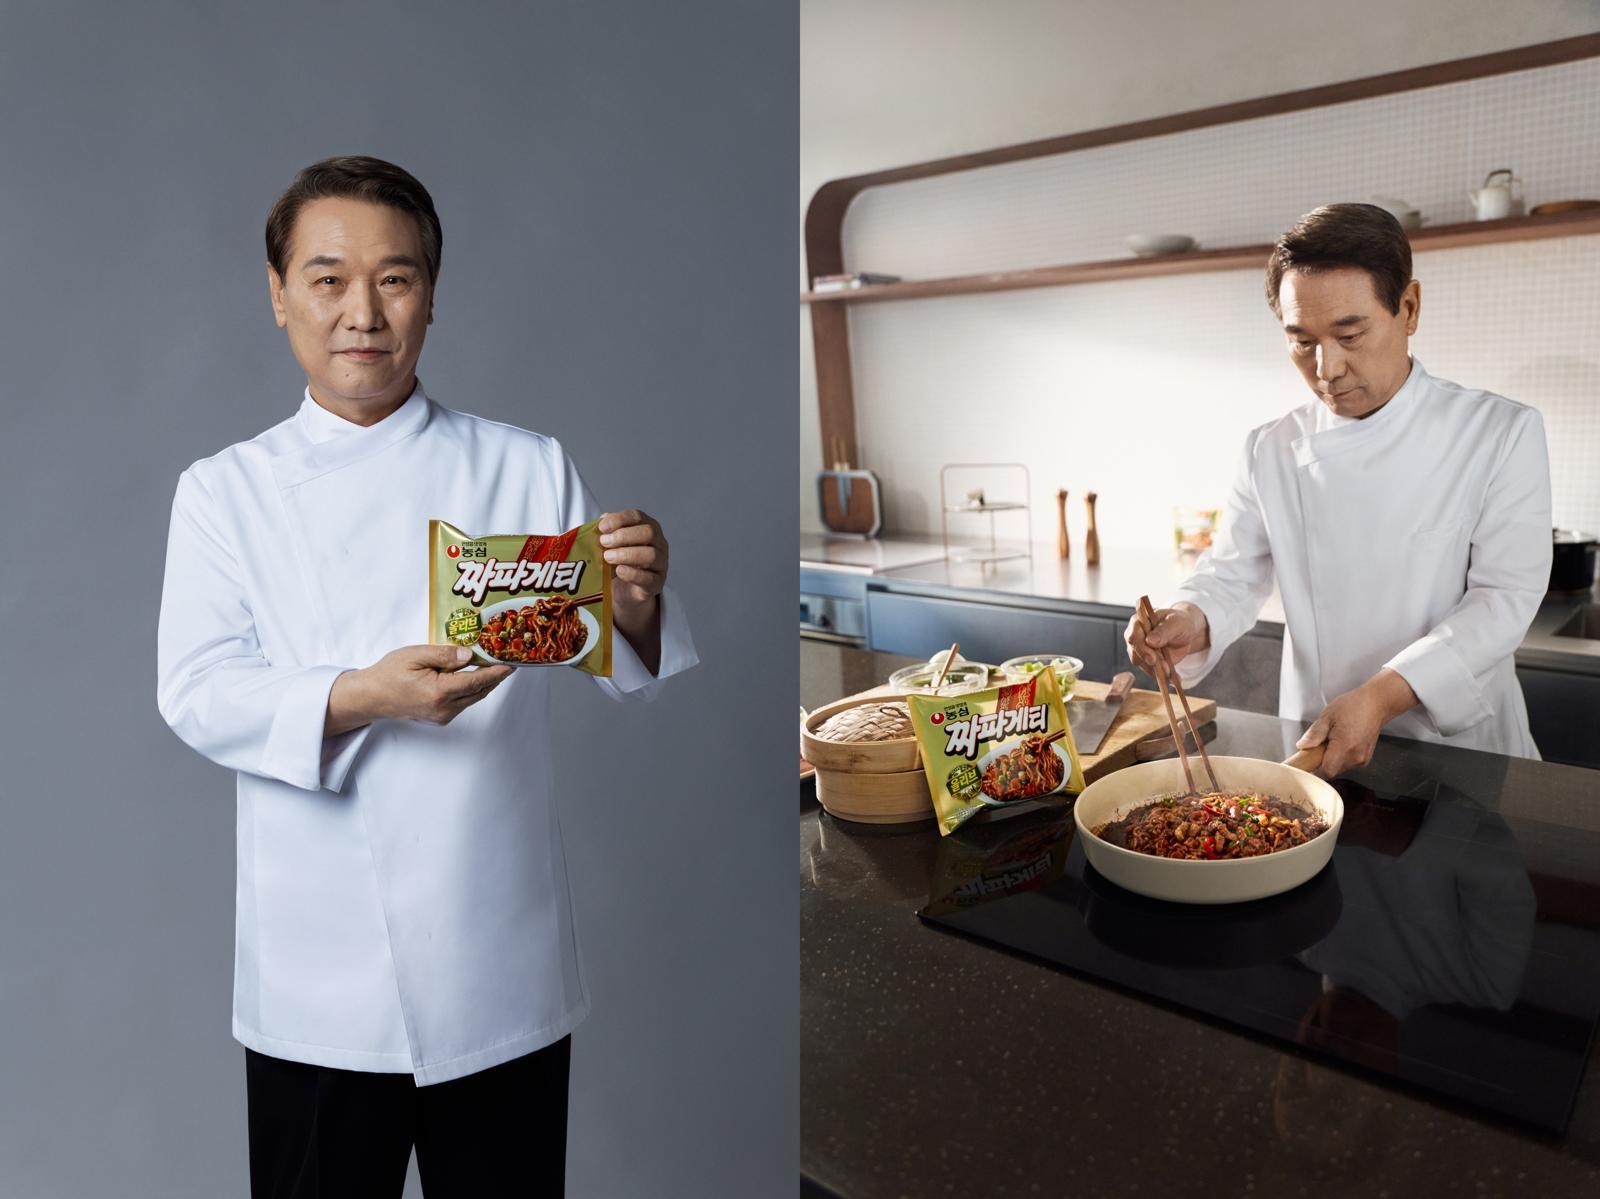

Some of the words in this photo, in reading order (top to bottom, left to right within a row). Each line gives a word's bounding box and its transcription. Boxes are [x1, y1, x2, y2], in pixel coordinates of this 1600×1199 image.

[461, 547, 487, 558] 농심
[452, 558, 586, 607] 짜파게티
[448, 617, 479, 636] 올리브
[945, 706, 970, 721] 농심
[944, 704, 1048, 760] 짜파게티
[950, 769, 979, 793] 올리브
